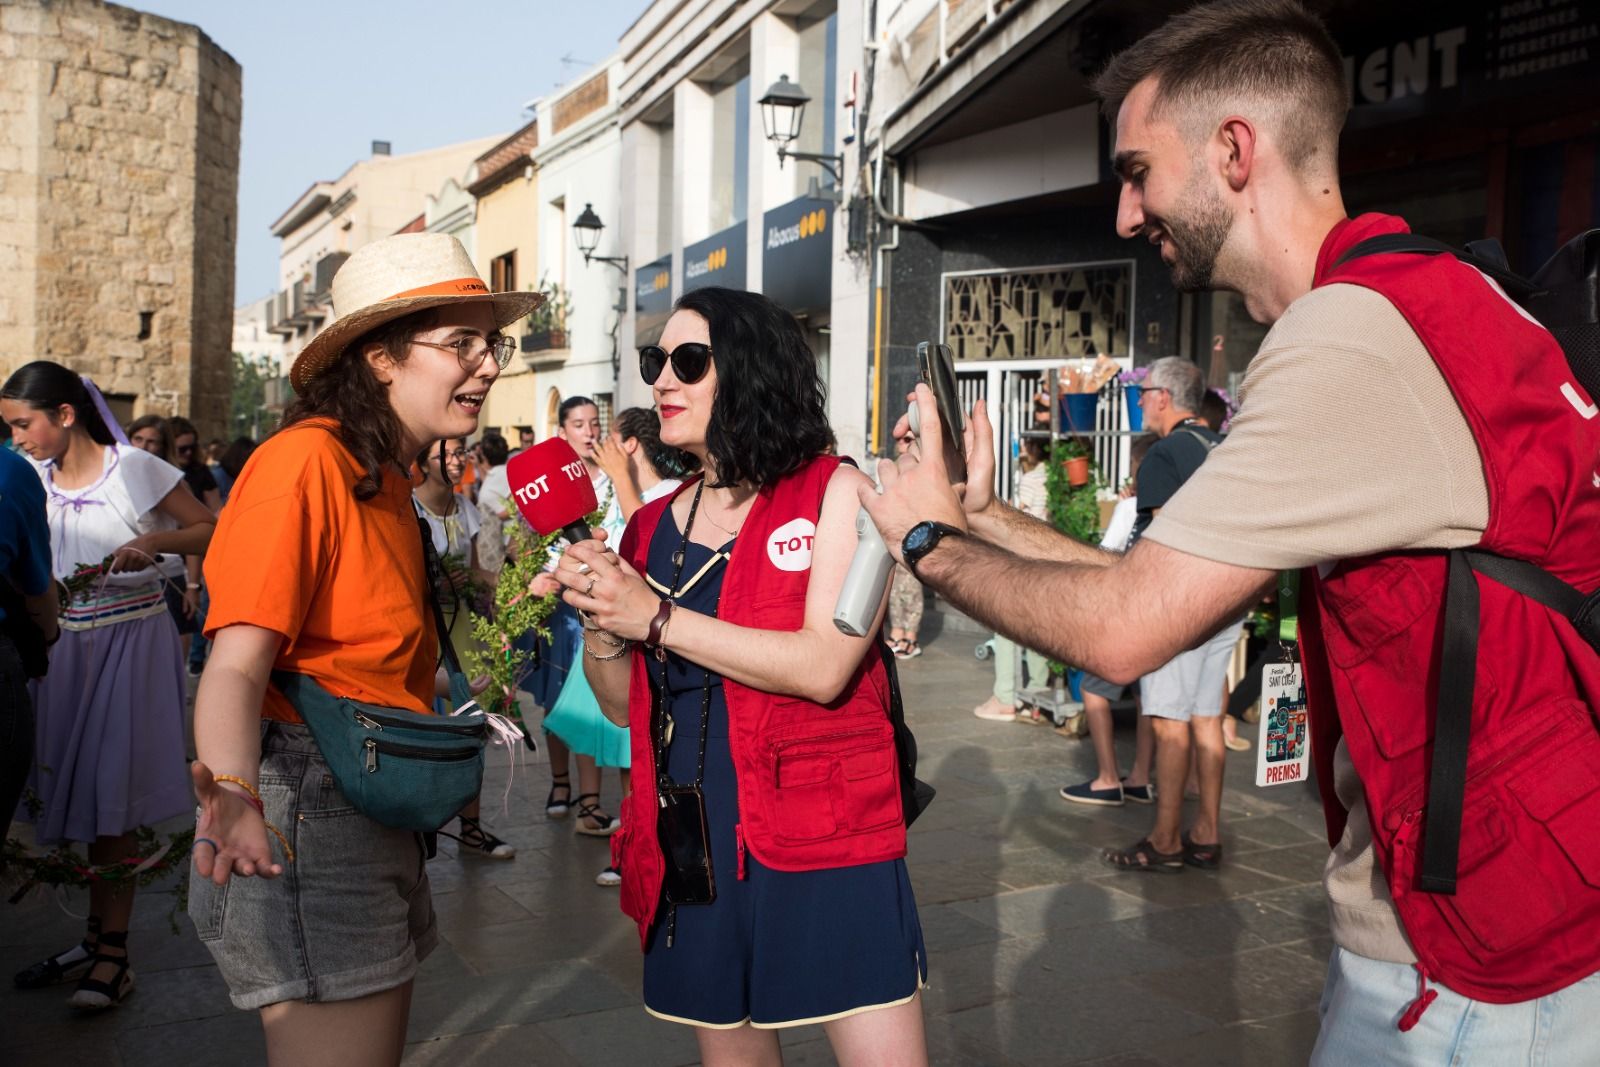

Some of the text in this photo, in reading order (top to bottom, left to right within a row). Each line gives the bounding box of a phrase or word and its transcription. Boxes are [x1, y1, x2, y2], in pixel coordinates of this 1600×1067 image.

[767, 223, 800, 250] Abacus
[560, 459, 586, 481] TOT
[515, 474, 550, 505] TOT
[774, 535, 814, 556] TOT
[1268, 675, 1281, 688] SANT
[1266, 762, 1301, 784] PREMSA
